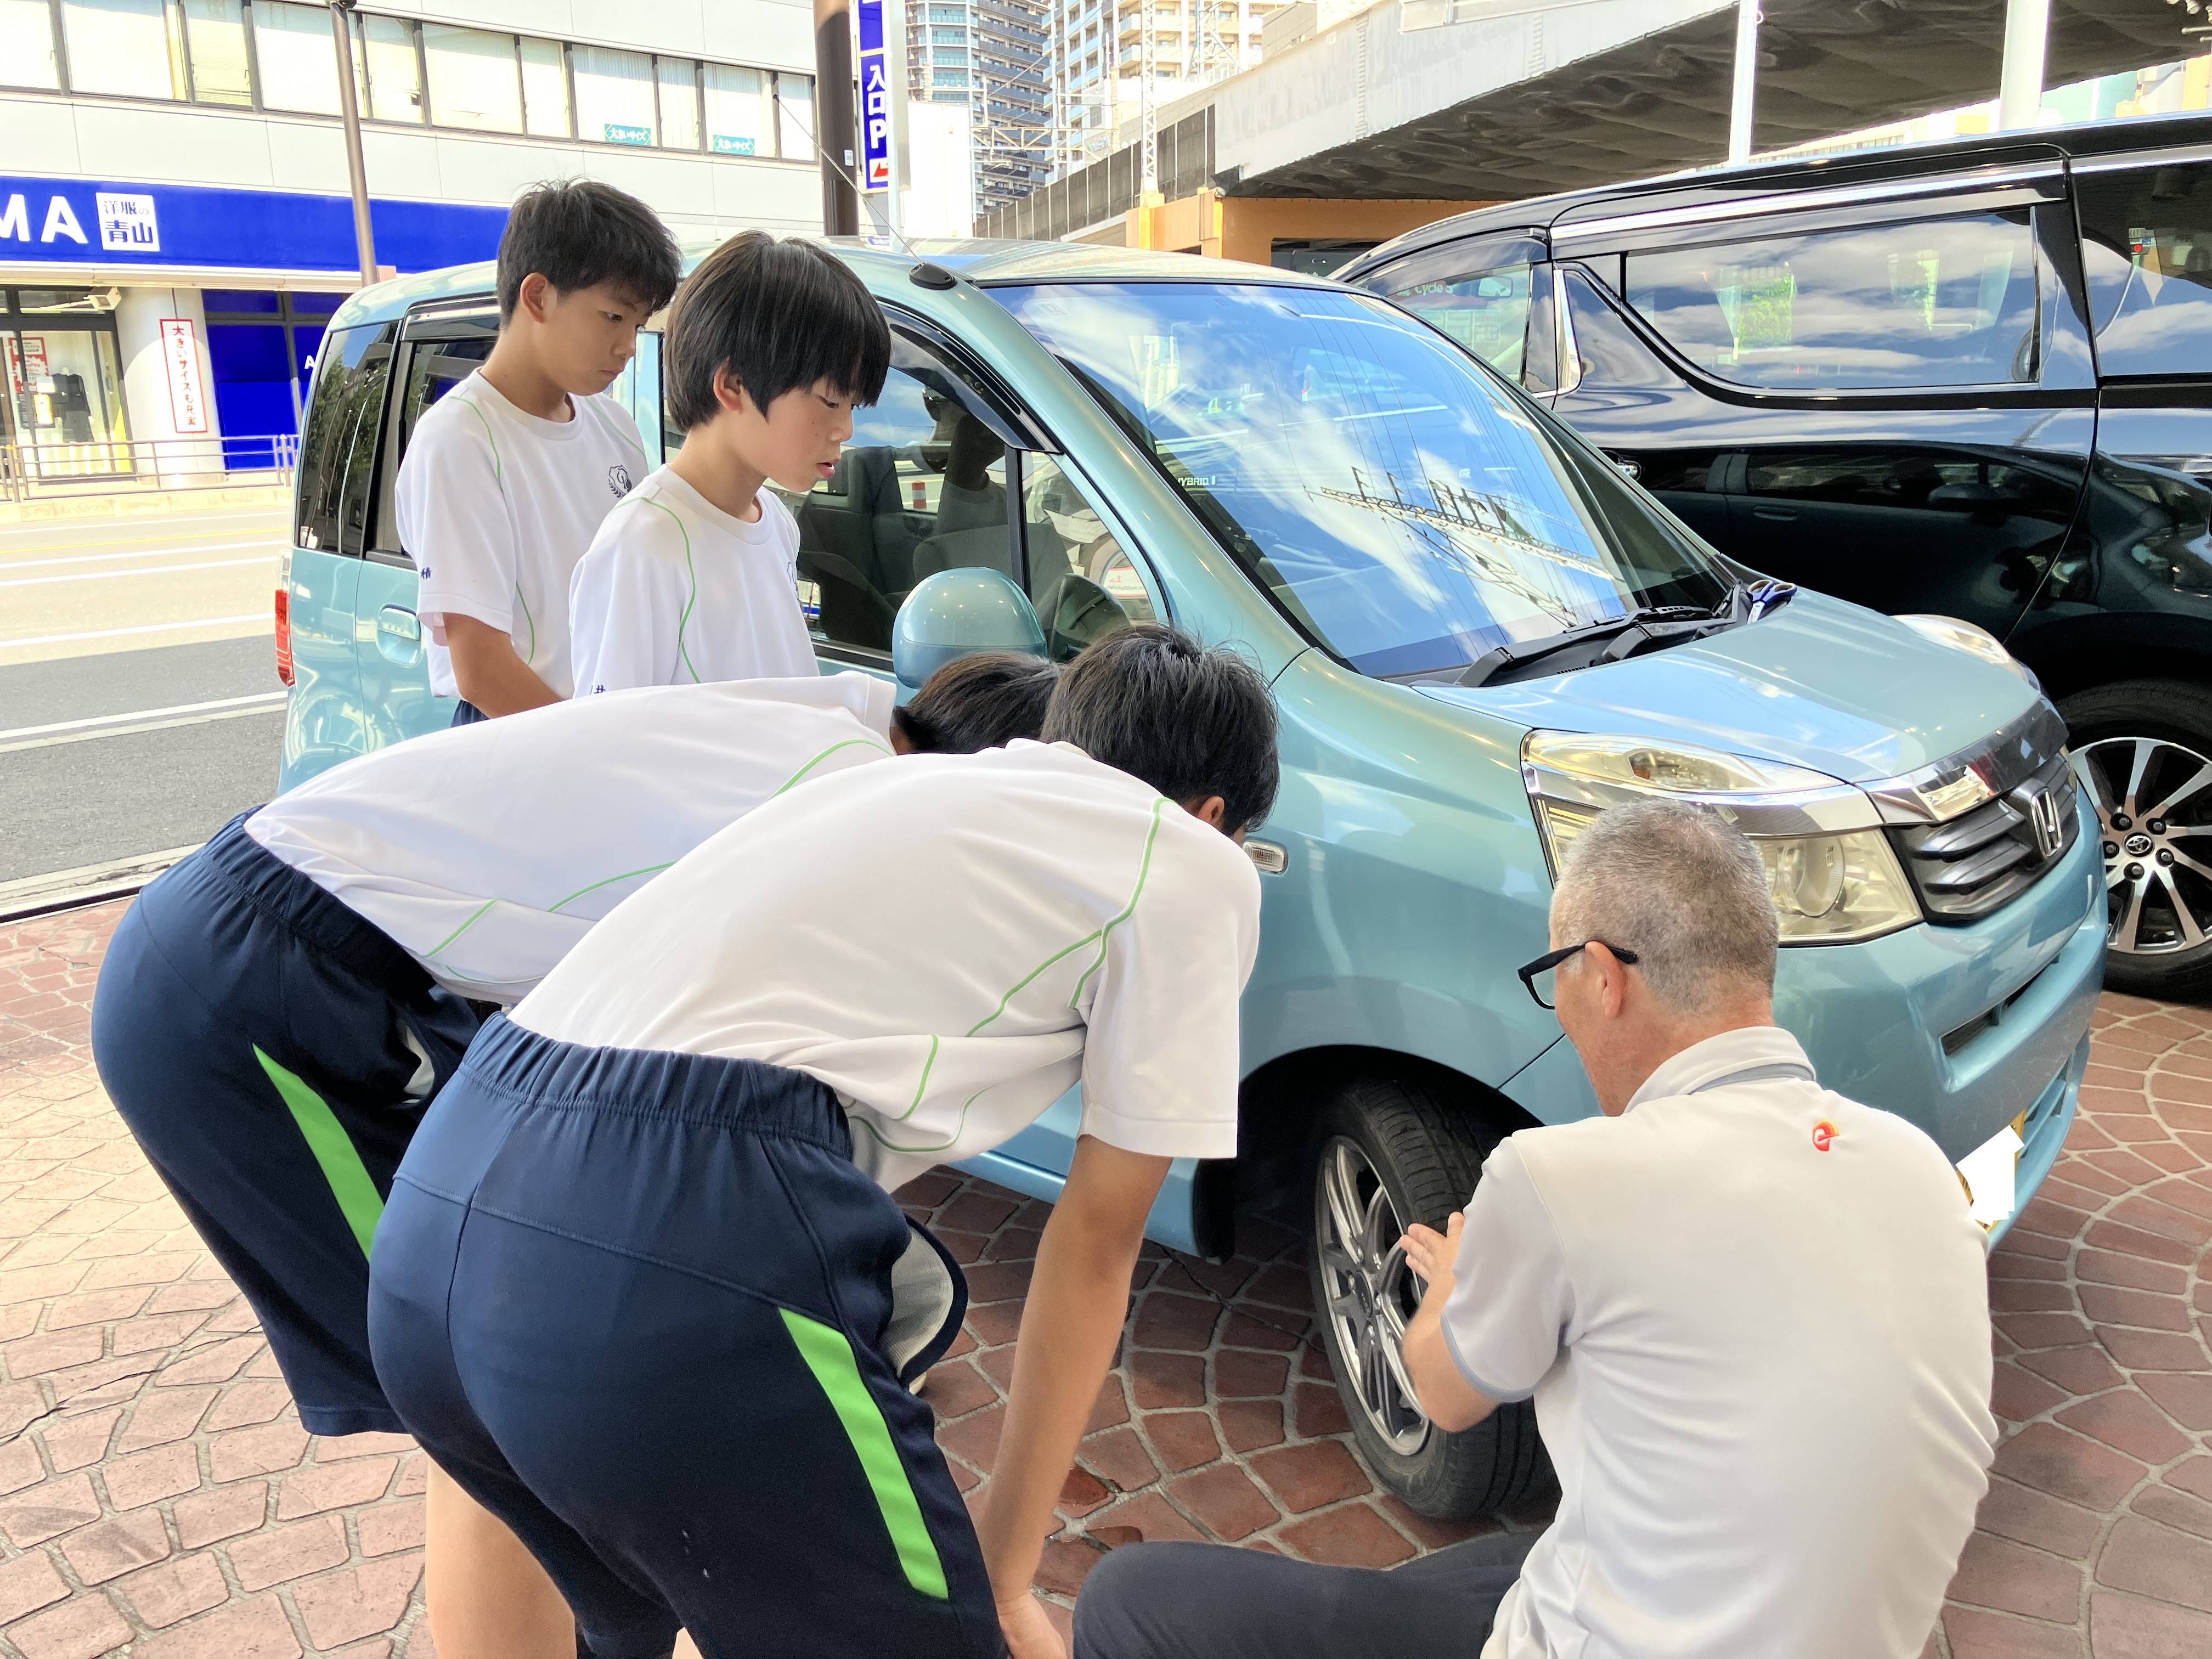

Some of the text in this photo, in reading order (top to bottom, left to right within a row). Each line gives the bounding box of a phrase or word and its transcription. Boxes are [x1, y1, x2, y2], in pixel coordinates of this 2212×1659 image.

[103, 200, 149, 216] 洋服の
[105, 219, 153, 243] 青山
